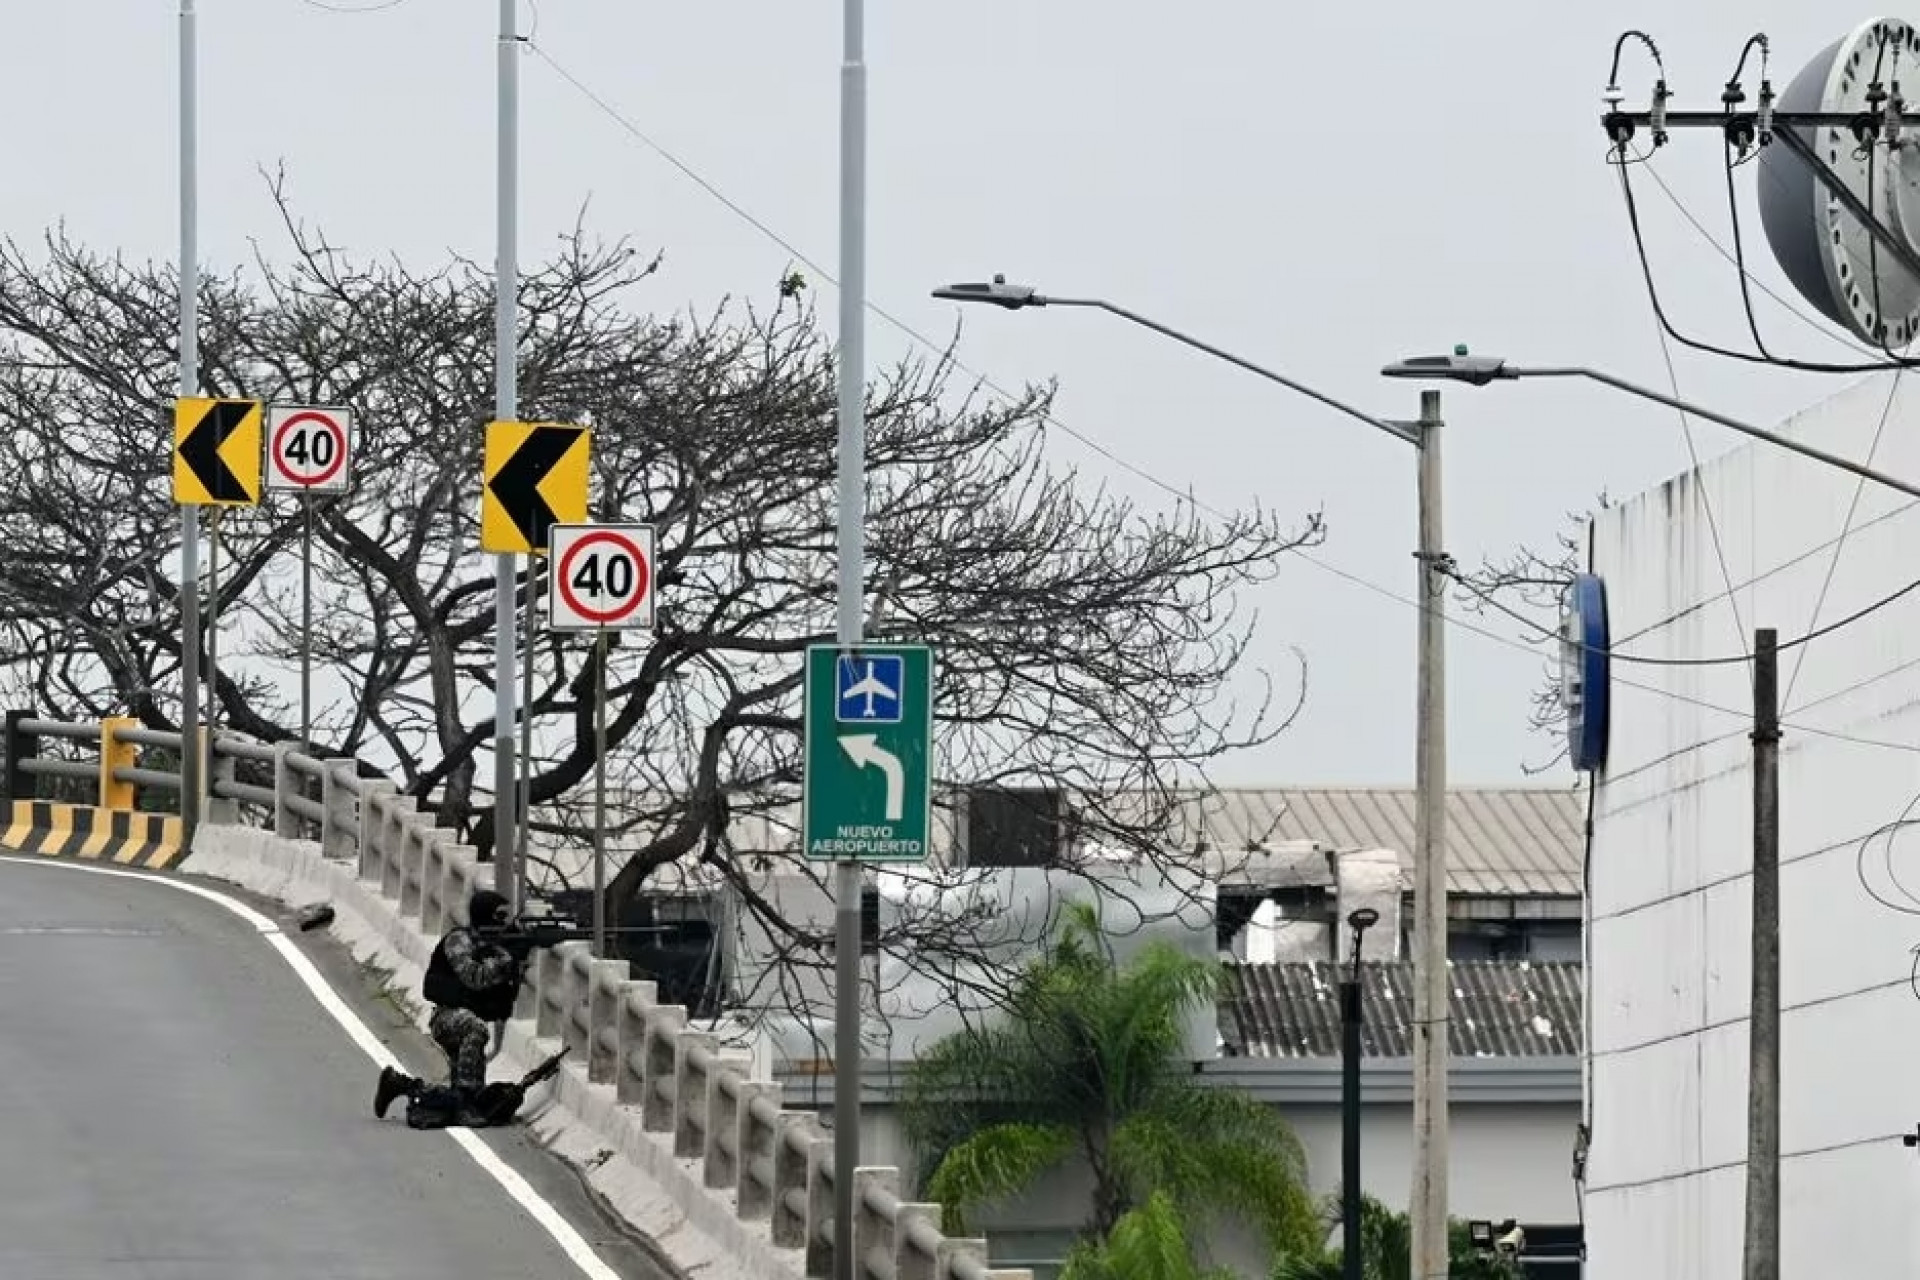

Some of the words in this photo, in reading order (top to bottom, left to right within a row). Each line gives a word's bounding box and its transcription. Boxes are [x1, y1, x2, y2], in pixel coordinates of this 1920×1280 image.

[284, 428, 333, 467] 40
[572, 552, 633, 598] 40
[838, 826, 893, 838] NUEVO
[811, 840, 920, 852] AEROPUERTO
